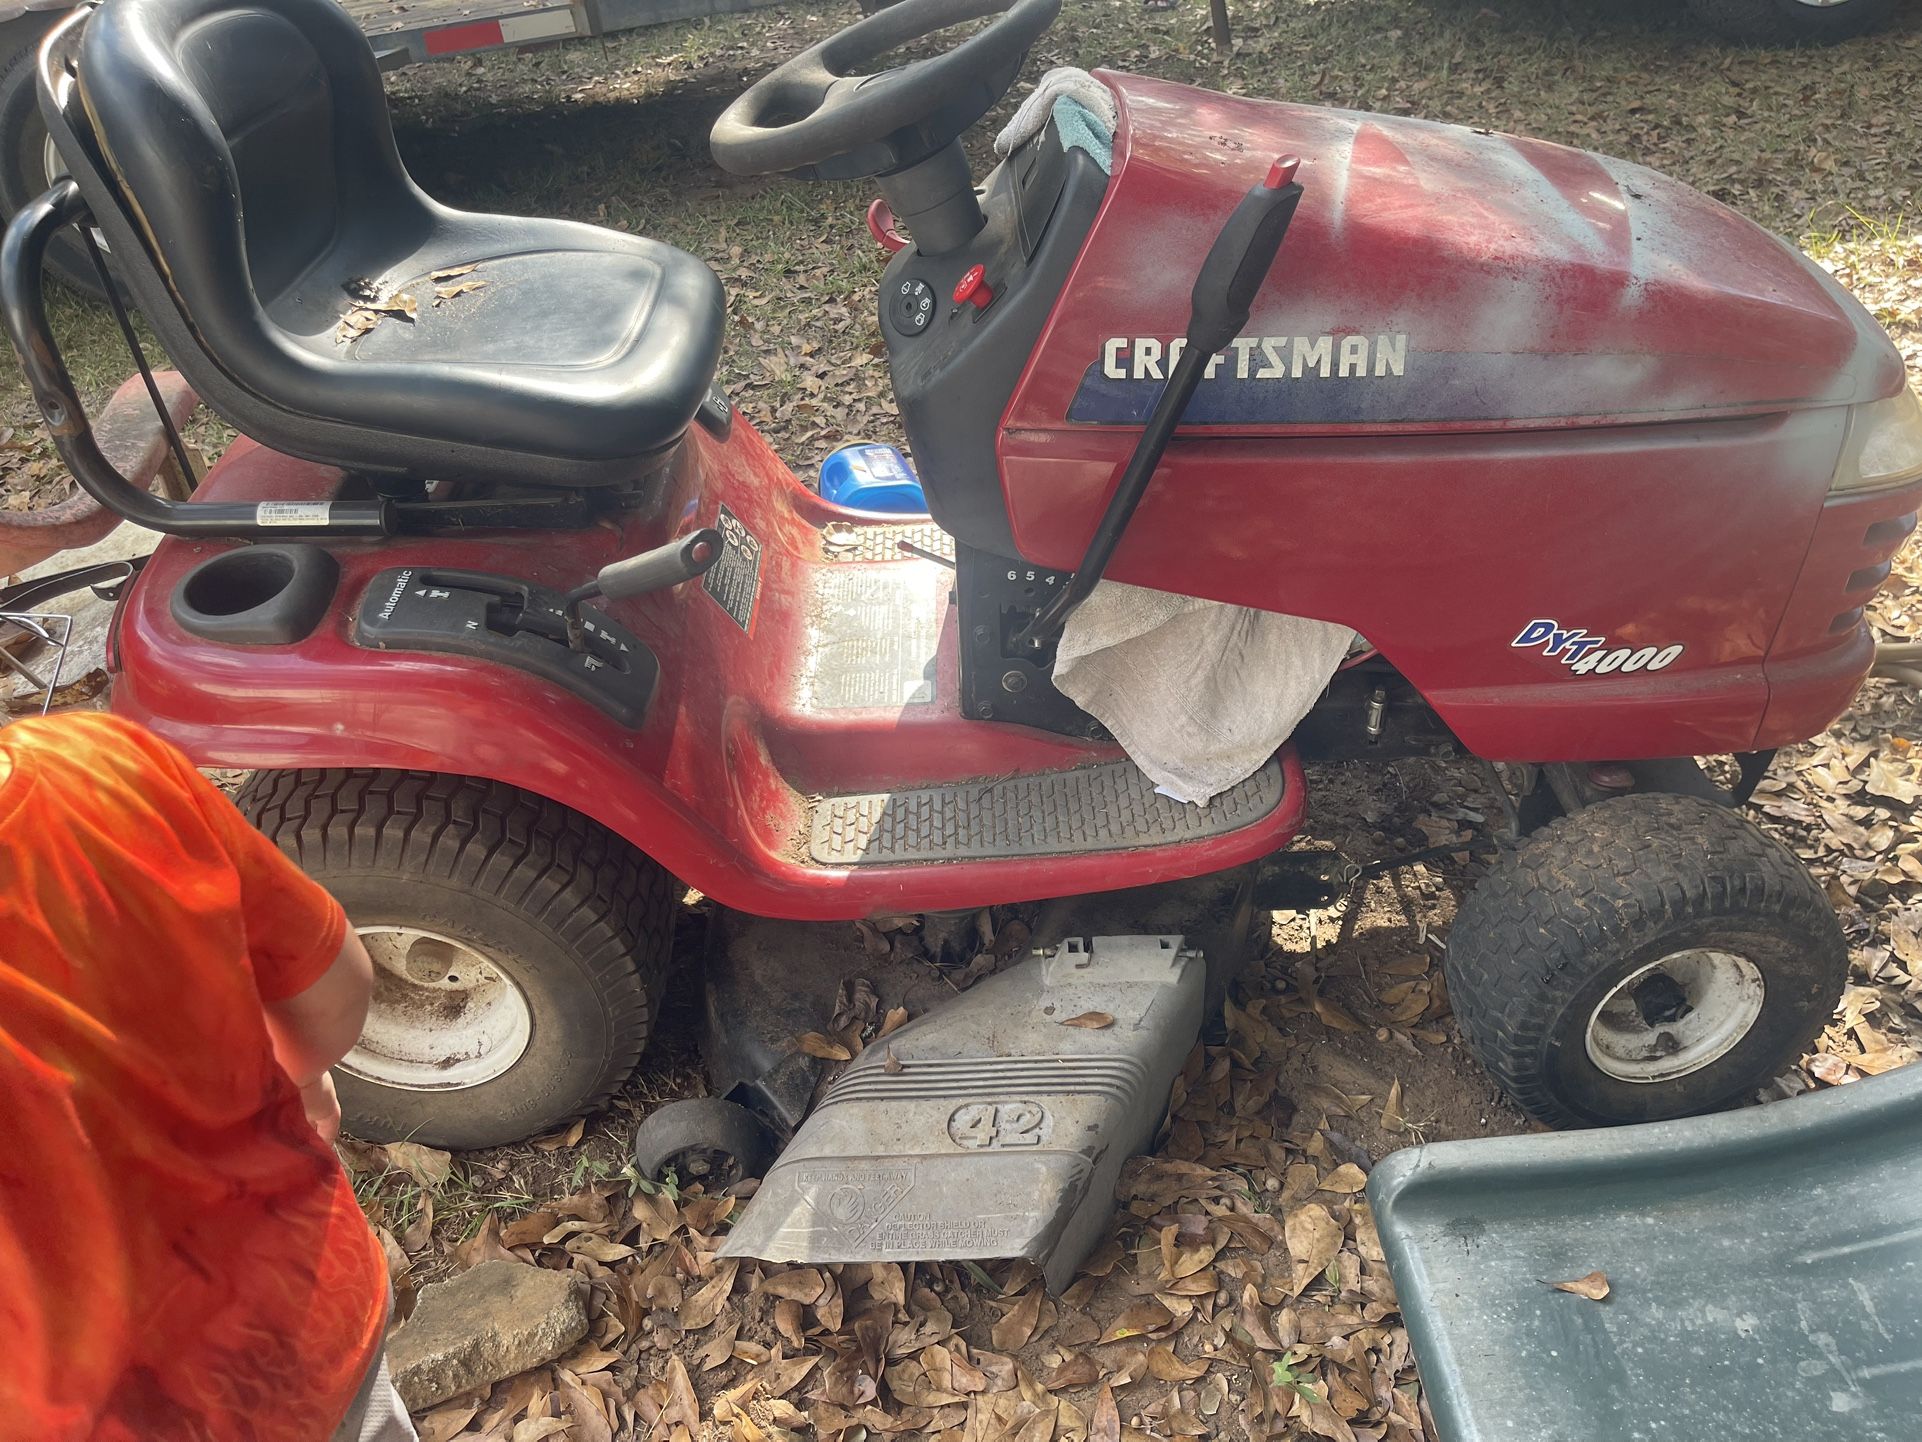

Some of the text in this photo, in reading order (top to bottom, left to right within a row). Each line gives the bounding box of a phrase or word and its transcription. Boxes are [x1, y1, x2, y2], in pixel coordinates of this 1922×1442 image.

[1007, 571, 1017, 580] 6
[1025, 571, 1035, 580] 5
[1045, 576, 1055, 585] 4
[378, 569, 412, 621] Automatic
[1511, 619, 1606, 664] DYT
[1570, 644, 1684, 675] 4000
[958, 1103, 1044, 1147] 42
[894, 1212, 931, 1221] CAUTION
[886, 1220, 986, 1231] DEFLECTOR SHIELD OR
[877, 1229, 1009, 1240] ENTIRE GRASS CATCHER MUST
[869, 1238, 999, 1250] BE IN PLACE WHILE MOWING
